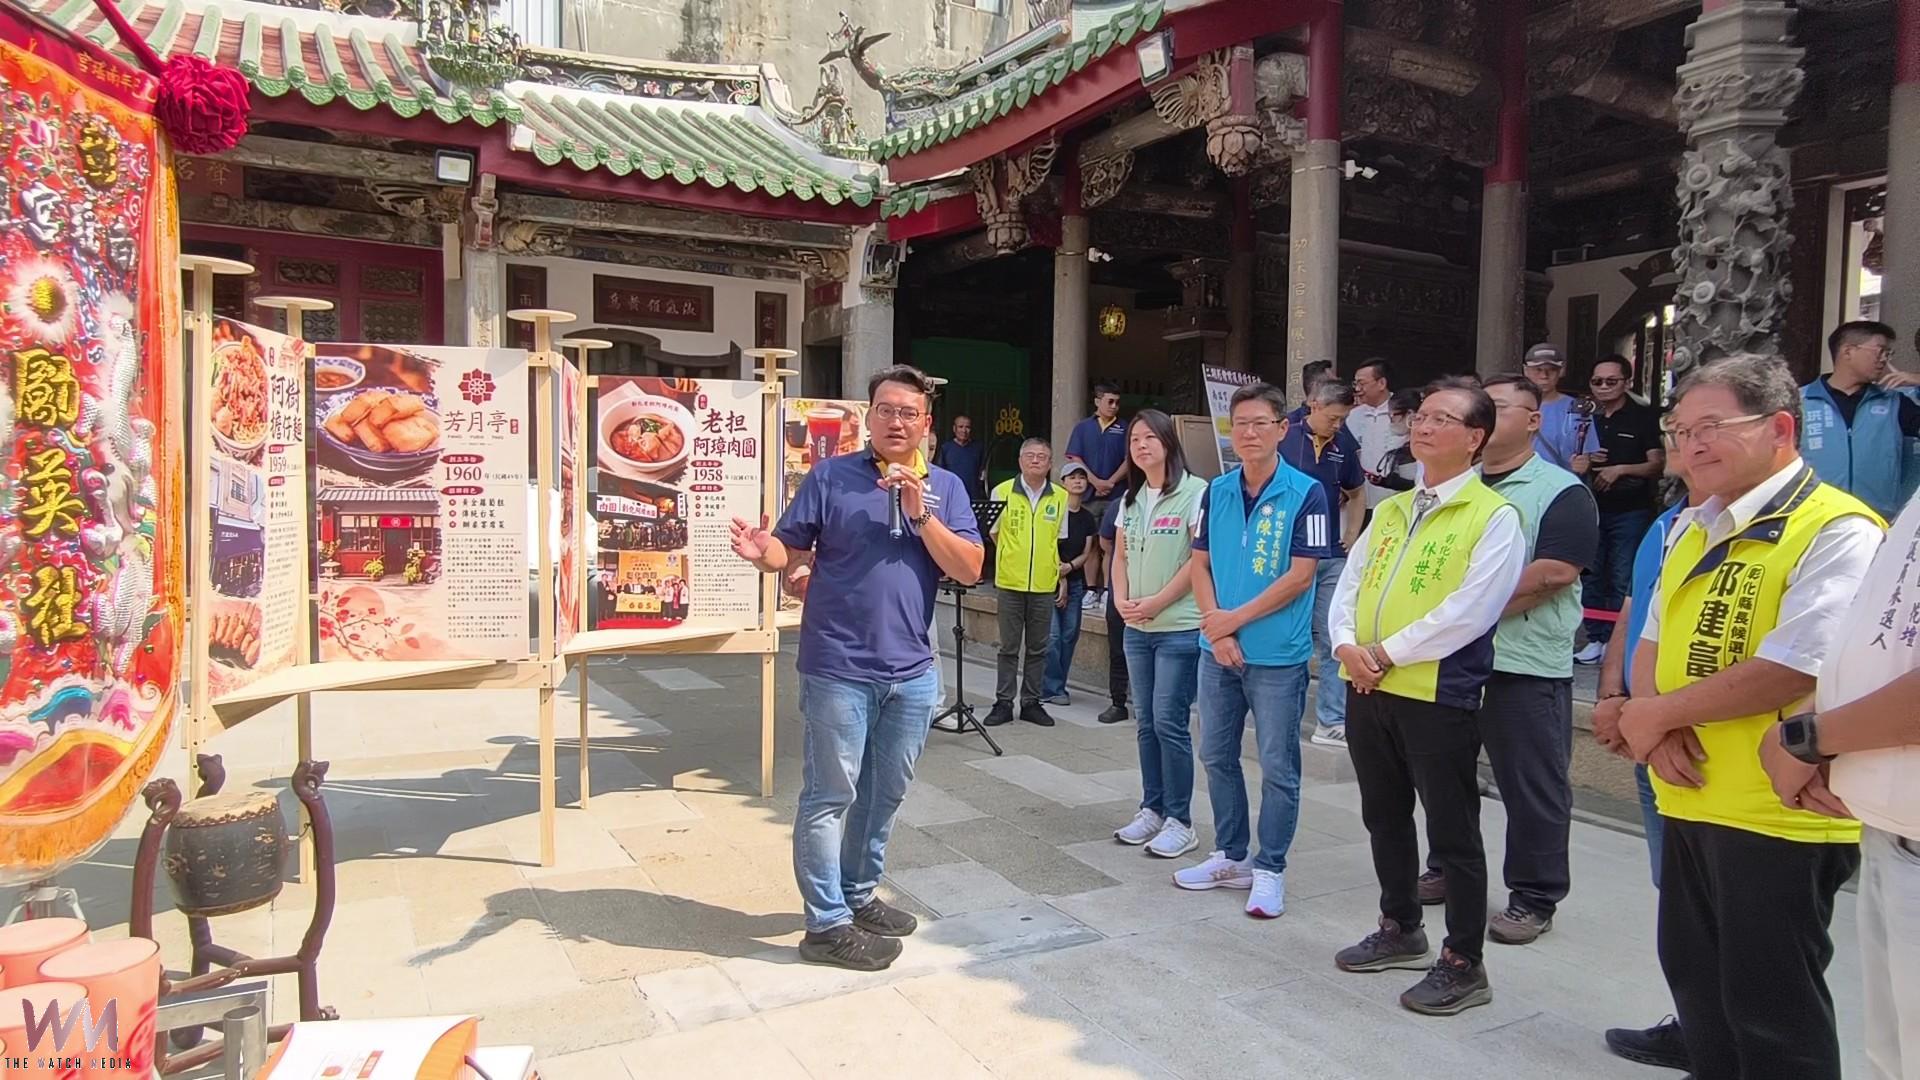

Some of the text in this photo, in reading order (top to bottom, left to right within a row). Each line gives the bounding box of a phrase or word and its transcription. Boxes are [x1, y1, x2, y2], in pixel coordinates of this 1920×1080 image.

[444, 410, 508, 433] 芳月亭
[701, 408, 748, 434] 老担
[693, 436, 757, 459] 阿璋肉圓
[269, 456, 287, 473] 1959
[445, 466, 482, 481] 1960
[694, 469, 723, 481] 1958
[1410, 541, 1436, 595] 林世賢
[1431, 533, 1457, 581] 彰化市長
